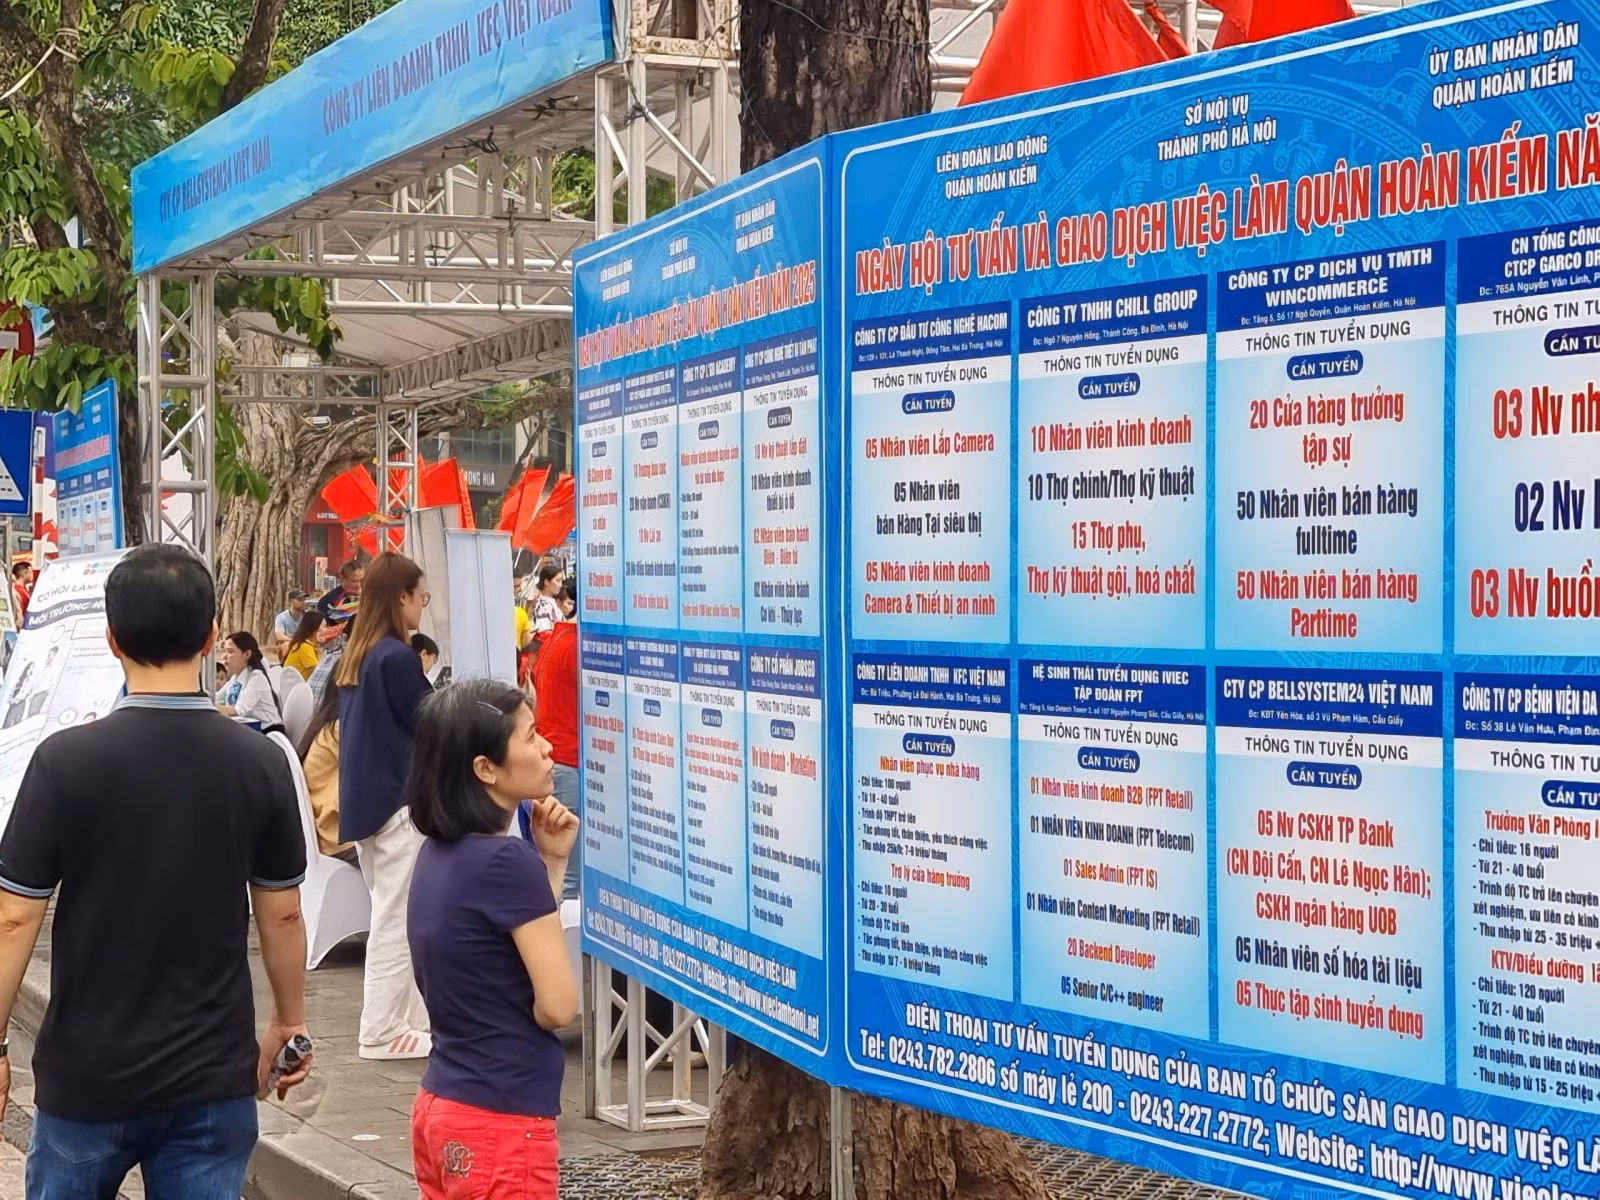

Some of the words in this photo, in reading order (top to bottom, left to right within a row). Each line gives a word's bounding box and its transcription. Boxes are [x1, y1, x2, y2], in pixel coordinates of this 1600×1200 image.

[1429, 51, 1449, 74] ỦY
[1453, 43, 1486, 70] BAN
[1491, 32, 1537, 62] NHÂN
[1542, 23, 1578, 51] DÂN
[1432, 79, 1475, 108] QUẬN
[1480, 69, 1525, 98] HOÀN
[1530, 59, 1573, 88] KIẾM
[1184, 98, 1202, 125] SỞ
[1205, 96, 1228, 121] NỘI
[1231, 94, 1248, 118] VỤ
[936, 150, 959, 172] LIÊN
[959, 145, 993, 168] ĐOÀN
[993, 142, 1014, 162] LAO
[1016, 135, 1047, 160] ĐỘNG
[1157, 135, 1198, 160] THÀNH
[1202, 129, 1228, 152] PHỐ
[1231, 124, 1249, 146] HÀ
[1253, 119, 1276, 144] NỘI
[945, 175, 973, 198] QUẬN
[976, 169, 1005, 192] HOÀN
[1008, 163, 1036, 186] KIẾM
[855, 237, 906, 295] NGÀY
[909, 229, 942, 295] HỘI
[945, 227, 974, 282] TƯ
[974, 211, 1018, 278] VẤN
[1022, 210, 1050, 271] VÀ
[1055, 211, 1107, 266] GIAO
[1111, 200, 1167, 267] DỊCH
[1171, 183, 1226, 256] VIỆC
[1232, 173, 1289, 240] LÀM
[1294, 158, 1371, 236] QUẬN
[1377, 143, 1459, 217] HOÀN
[1466, 120, 1548, 204] KIẾM
[1555, 112, 1600, 190] NĂ
[1228, 270, 1268, 290] CÔNG
[1272, 267, 1289, 284] TY
[1294, 264, 1314, 281] CP
[1319, 257, 1356, 280] DỊCH
[1361, 254, 1382, 274] VỤ
[1386, 247, 1432, 268] TMTH
[1504, 258, 1536, 277] CTCP
[1539, 251, 1582, 273] GARCO
[769, 262, 792, 314] NĂM
[792, 260, 816, 307] 2025
[1265, 276, 1387, 306] WINCOMMERCE
[1027, 305, 1060, 328] CÔNG
[1063, 304, 1077, 323] TY
[1080, 300, 1112, 321] TNHH
[1115, 295, 1150, 317] CHILL
[1153, 289, 1197, 312] GROUP
[1249, 399, 1268, 429] 20
[1272, 393, 1302, 427] Cửa
[1306, 393, 1345, 426] hàng
[1350, 386, 1403, 422] trưởng
[865, 438, 877, 458] 05
[879, 436, 905, 457] Nhân
[908, 434, 929, 455] viên
[932, 428, 950, 456] Lắp
[953, 431, 994, 452] Camera
[1302, 434, 1327, 469] tập
[1332, 433, 1352, 467] sự
[1071, 521, 1086, 549] 15
[1090, 520, 1113, 555] Thợ
[1117, 520, 1145, 554] phụ,
[1073, 684, 1092, 702] TẬP
[1094, 687, 1122, 701] ĐOÀN
[1124, 688, 1142, 702] FPT
[1223, 678, 1245, 698] CTY
[1248, 679, 1264, 698] CP
[1268, 680, 1364, 702] BELLSYSTEM24
[1367, 683, 1396, 708] VIỆT
[1400, 684, 1432, 705] NAM
[1493, 721, 1503, 732] 38
[1063, 857, 1072, 876] 01
[1074, 859, 1096, 880] Sales
[1098, 862, 1124, 883] Admin
[1126, 866, 1144, 886] (FPT
[1145, 868, 1157, 890] IS)
[1067, 937, 1077, 956] 20
[1078, 938, 1112, 962] Backend
[1114, 944, 1155, 970] Developer
[1060, 975, 1071, 994] 05
[1072, 977, 1098, 999] Senior
[1099, 982, 1125, 1003] C/C++
[1127, 990, 1163, 1012] engineer
[860, 1028, 884, 1060] Tel:
[888, 1036, 995, 1086] 0243.782.2806
[1000, 1062, 1018, 1092] số
[1023, 1069, 1056, 1104] máy
[1061, 1074, 1076, 1106] lẻ
[1082, 1079, 1112, 1114] 200
[1130, 1091, 1269, 1154] 0243.227.2772;
[1275, 1122, 1363, 1172] Website:
[905, 1002, 940, 1033] ĐIỆN
[944, 1011, 987, 1045] THOẠI
[992, 1021, 1013, 1047] TƯ
[1015, 1024, 1048, 1055] VẤN
[1052, 1034, 1105, 1068] TUYỂN
[1111, 1046, 1159, 1080] DỤNG
[1165, 1051, 1201, 1089] CỦA
[1207, 1066, 1246, 1098] BAN
[1251, 1068, 1275, 1104] TỔ
[1281, 1079, 1335, 1116] CHỨC
[1342, 1091, 1386, 1128] SÀN
[1393, 1104, 1444, 1140] GIAO
[1452, 1115, 1507, 1154] DỊCH
[1514, 1127, 1568, 1170] VIỆC
[1576, 1137, 1600, 1173] LÀ
